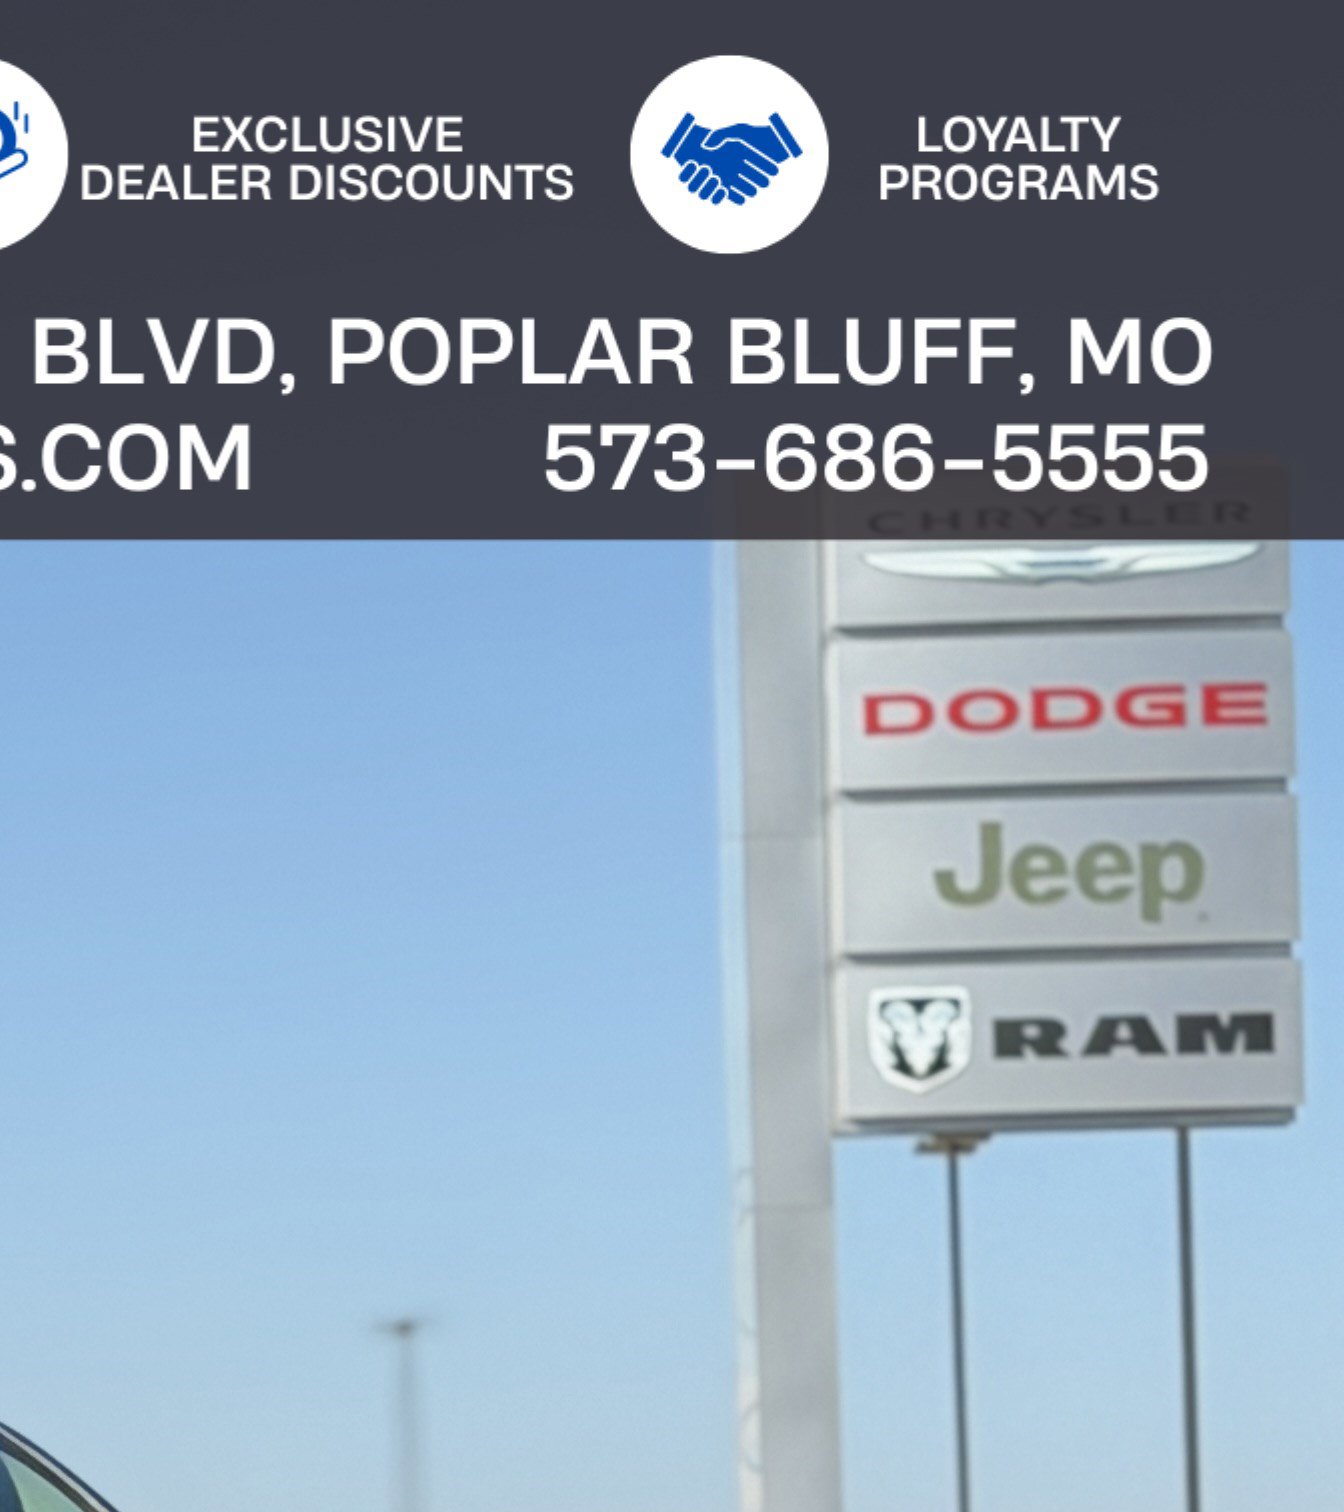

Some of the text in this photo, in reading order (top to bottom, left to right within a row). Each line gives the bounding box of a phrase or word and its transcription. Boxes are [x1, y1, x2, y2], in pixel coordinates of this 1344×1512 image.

[867, 500, 1252, 536] CHRYSLER
[863, 682, 1270, 737] DODGE
[933, 821, 1205, 924] Jeep
[992, 1012, 1275, 1060] RAM
